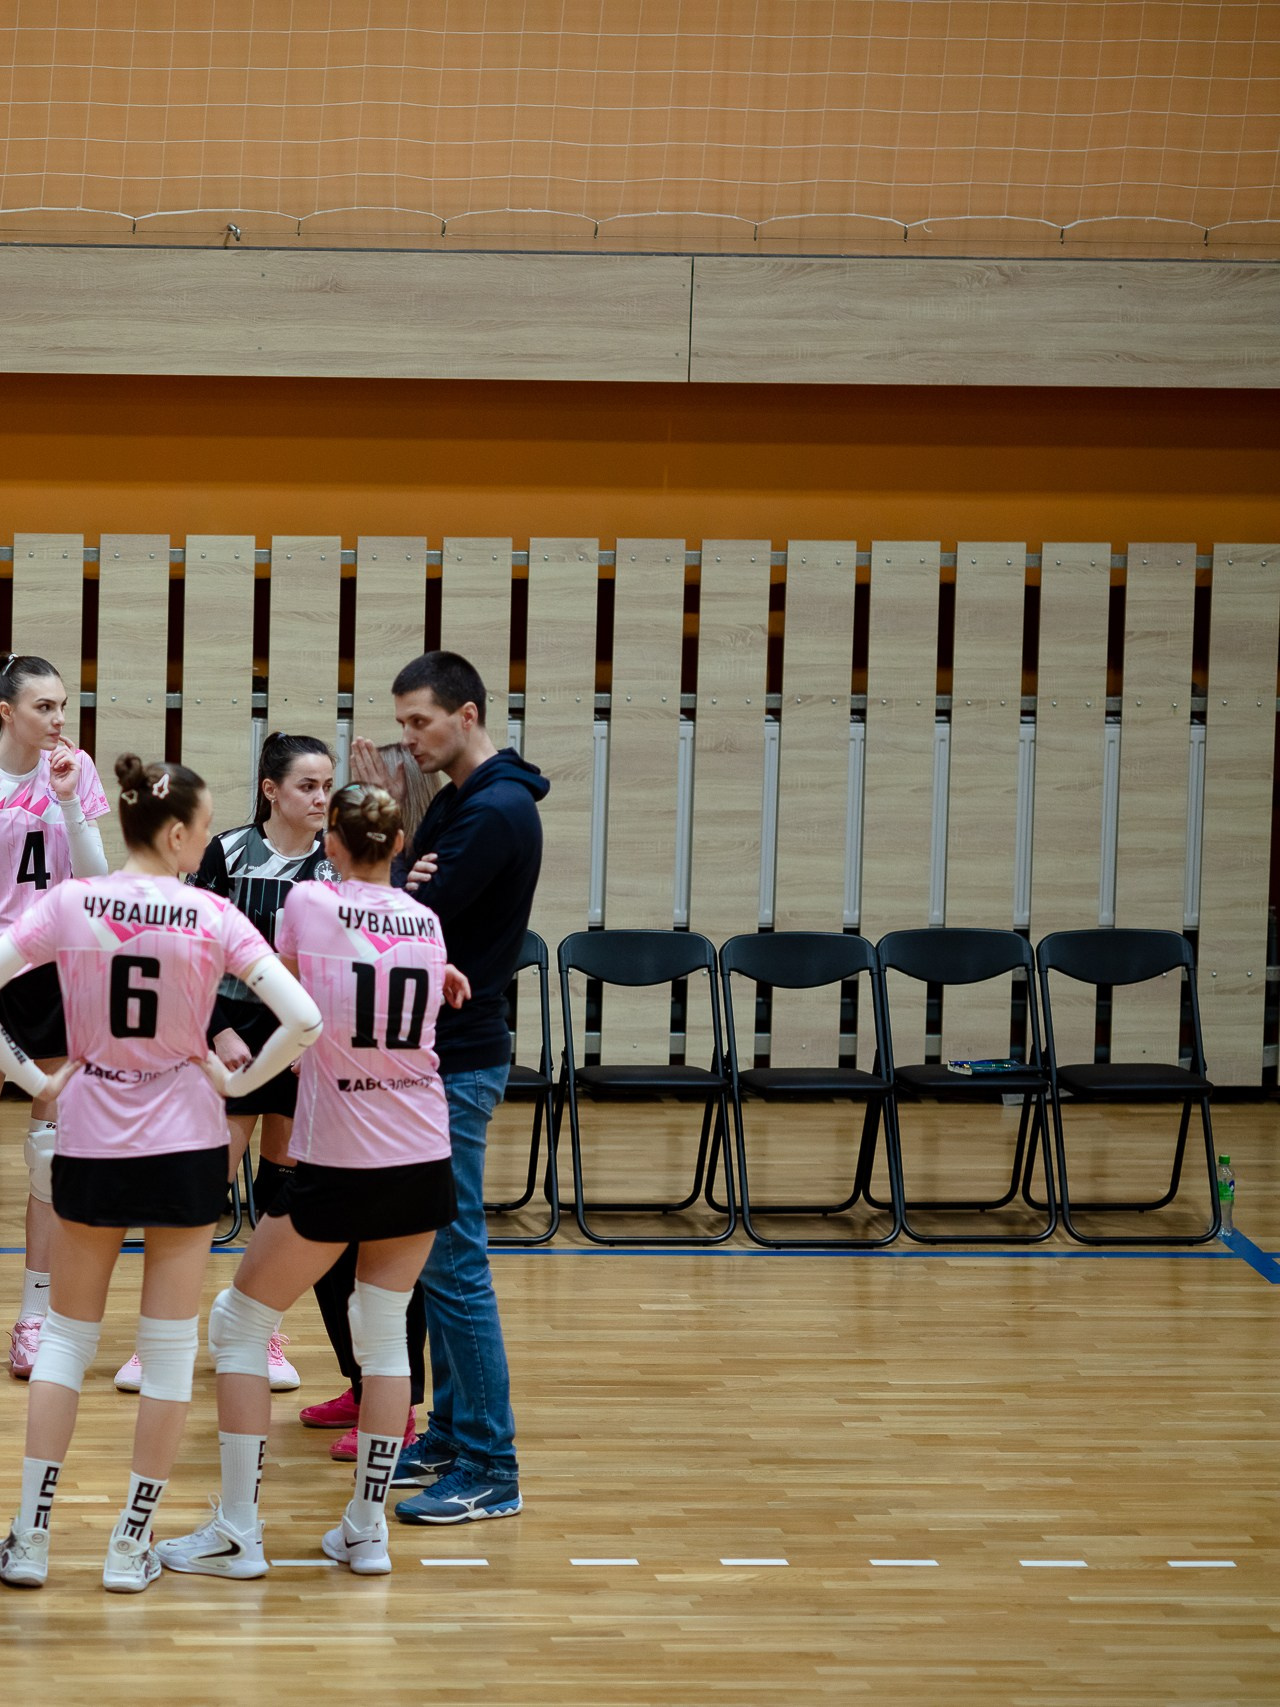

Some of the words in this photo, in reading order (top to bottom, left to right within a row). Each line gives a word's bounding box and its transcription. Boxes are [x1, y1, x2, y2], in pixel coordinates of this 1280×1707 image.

[16, 830, 51, 891] 4
[83, 896, 198, 930] ЧУВАШИЯ
[338, 905, 436, 939] ЧУВАШИЯ
[110, 954, 161, 1040] 6
[351, 961, 430, 1050] 10
